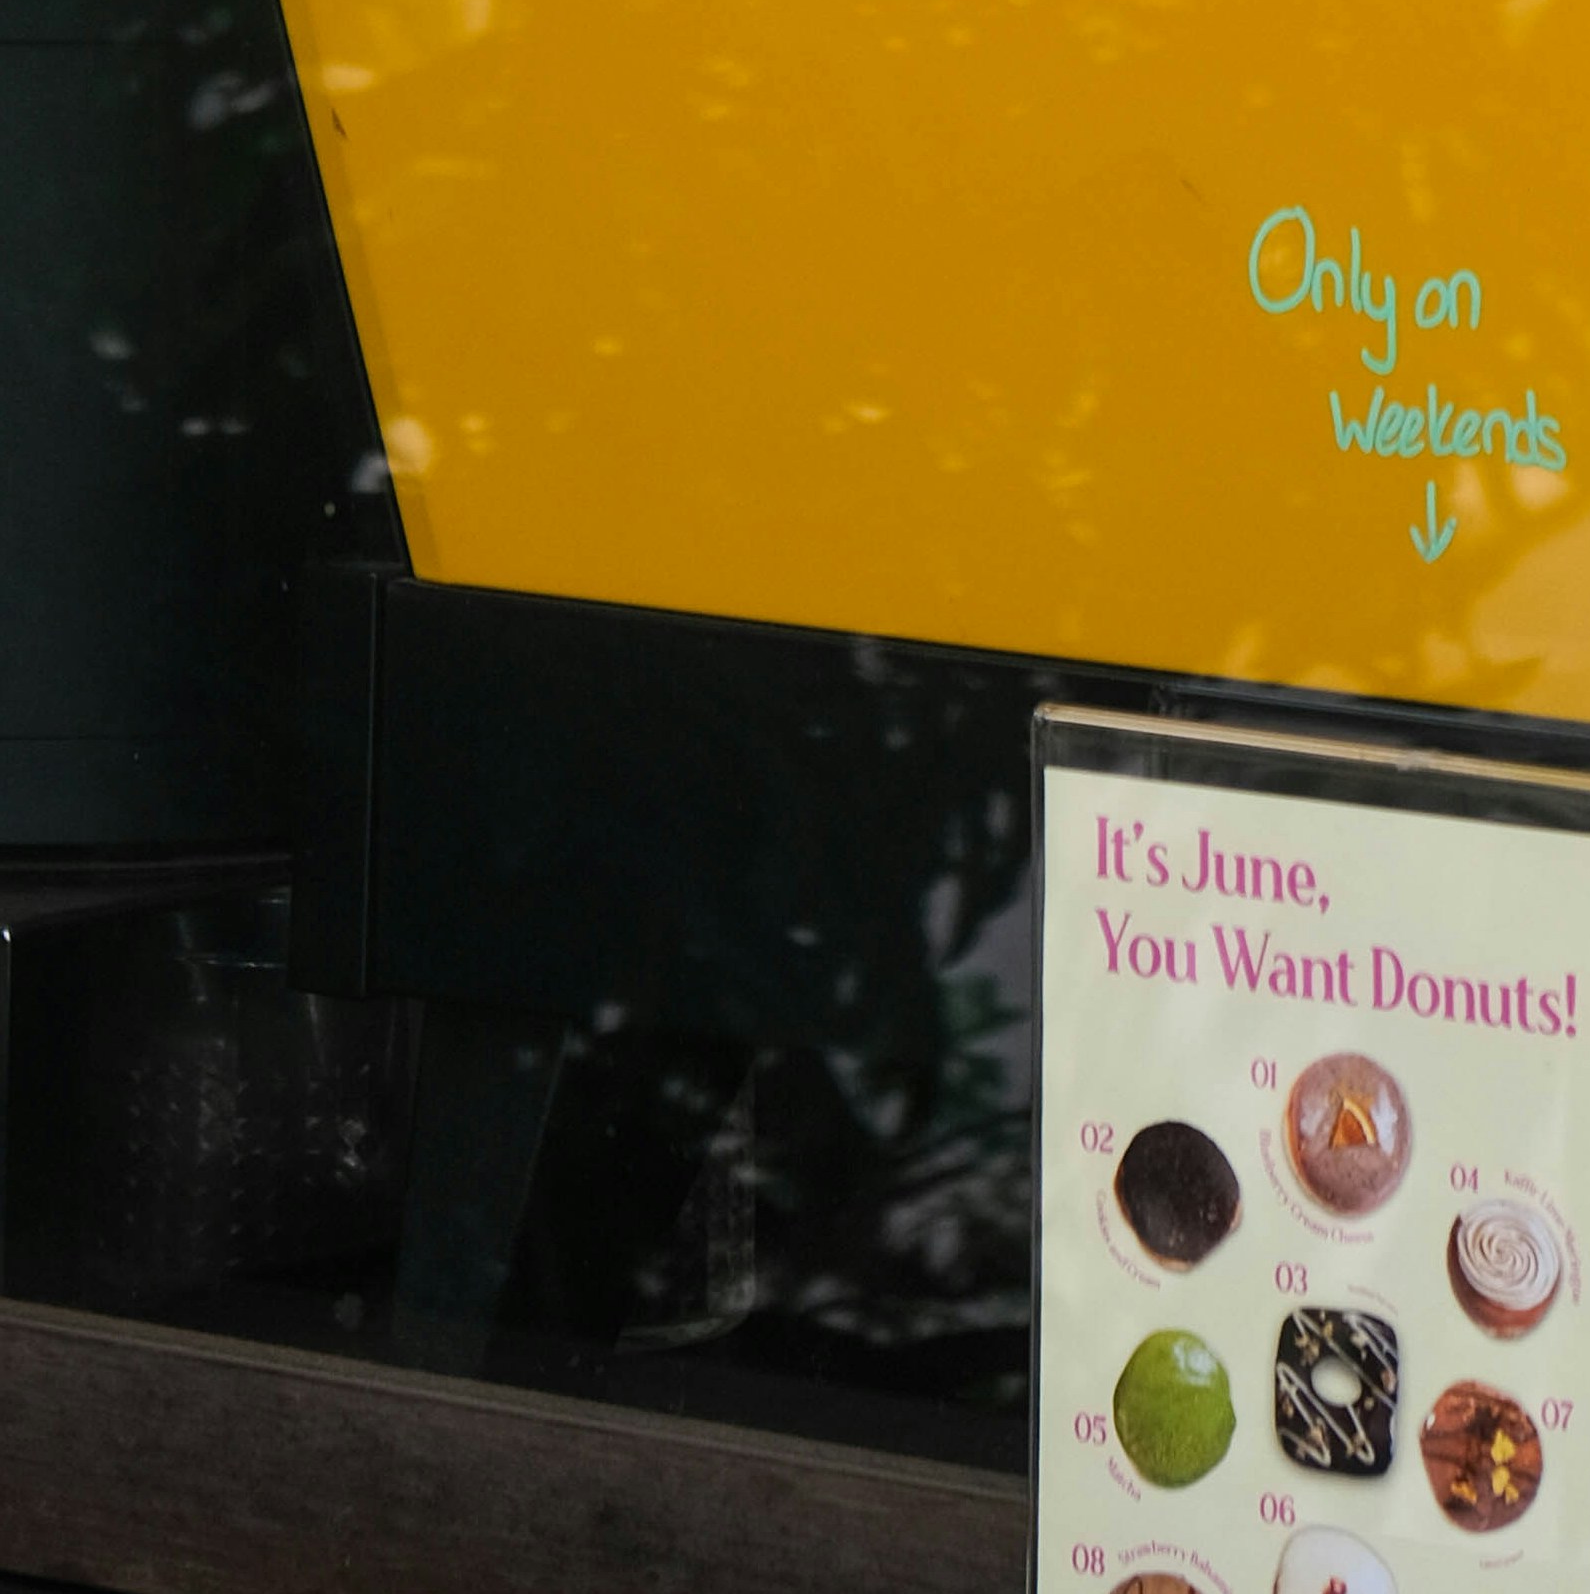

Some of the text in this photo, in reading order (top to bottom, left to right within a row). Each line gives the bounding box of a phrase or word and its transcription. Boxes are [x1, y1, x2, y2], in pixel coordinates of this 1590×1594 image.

[1249, 205, 1480, 375] Only on
[1095, 816, 1330, 913] It's June,
[1095, 909, 1578, 1038] You Want Donuts!
[1251, 1059, 1277, 1090] 01
[1081, 1122, 1114, 1154] 02
[1450, 1164, 1479, 1194] 04
[1275, 1261, 1308, 1294] 03
[1074, 1412, 1107, 1445] 05
[1542, 1398, 1574, 1431] 07
[1260, 1492, 1296, 1527] 06
[1072, 1543, 1106, 1576] 08
